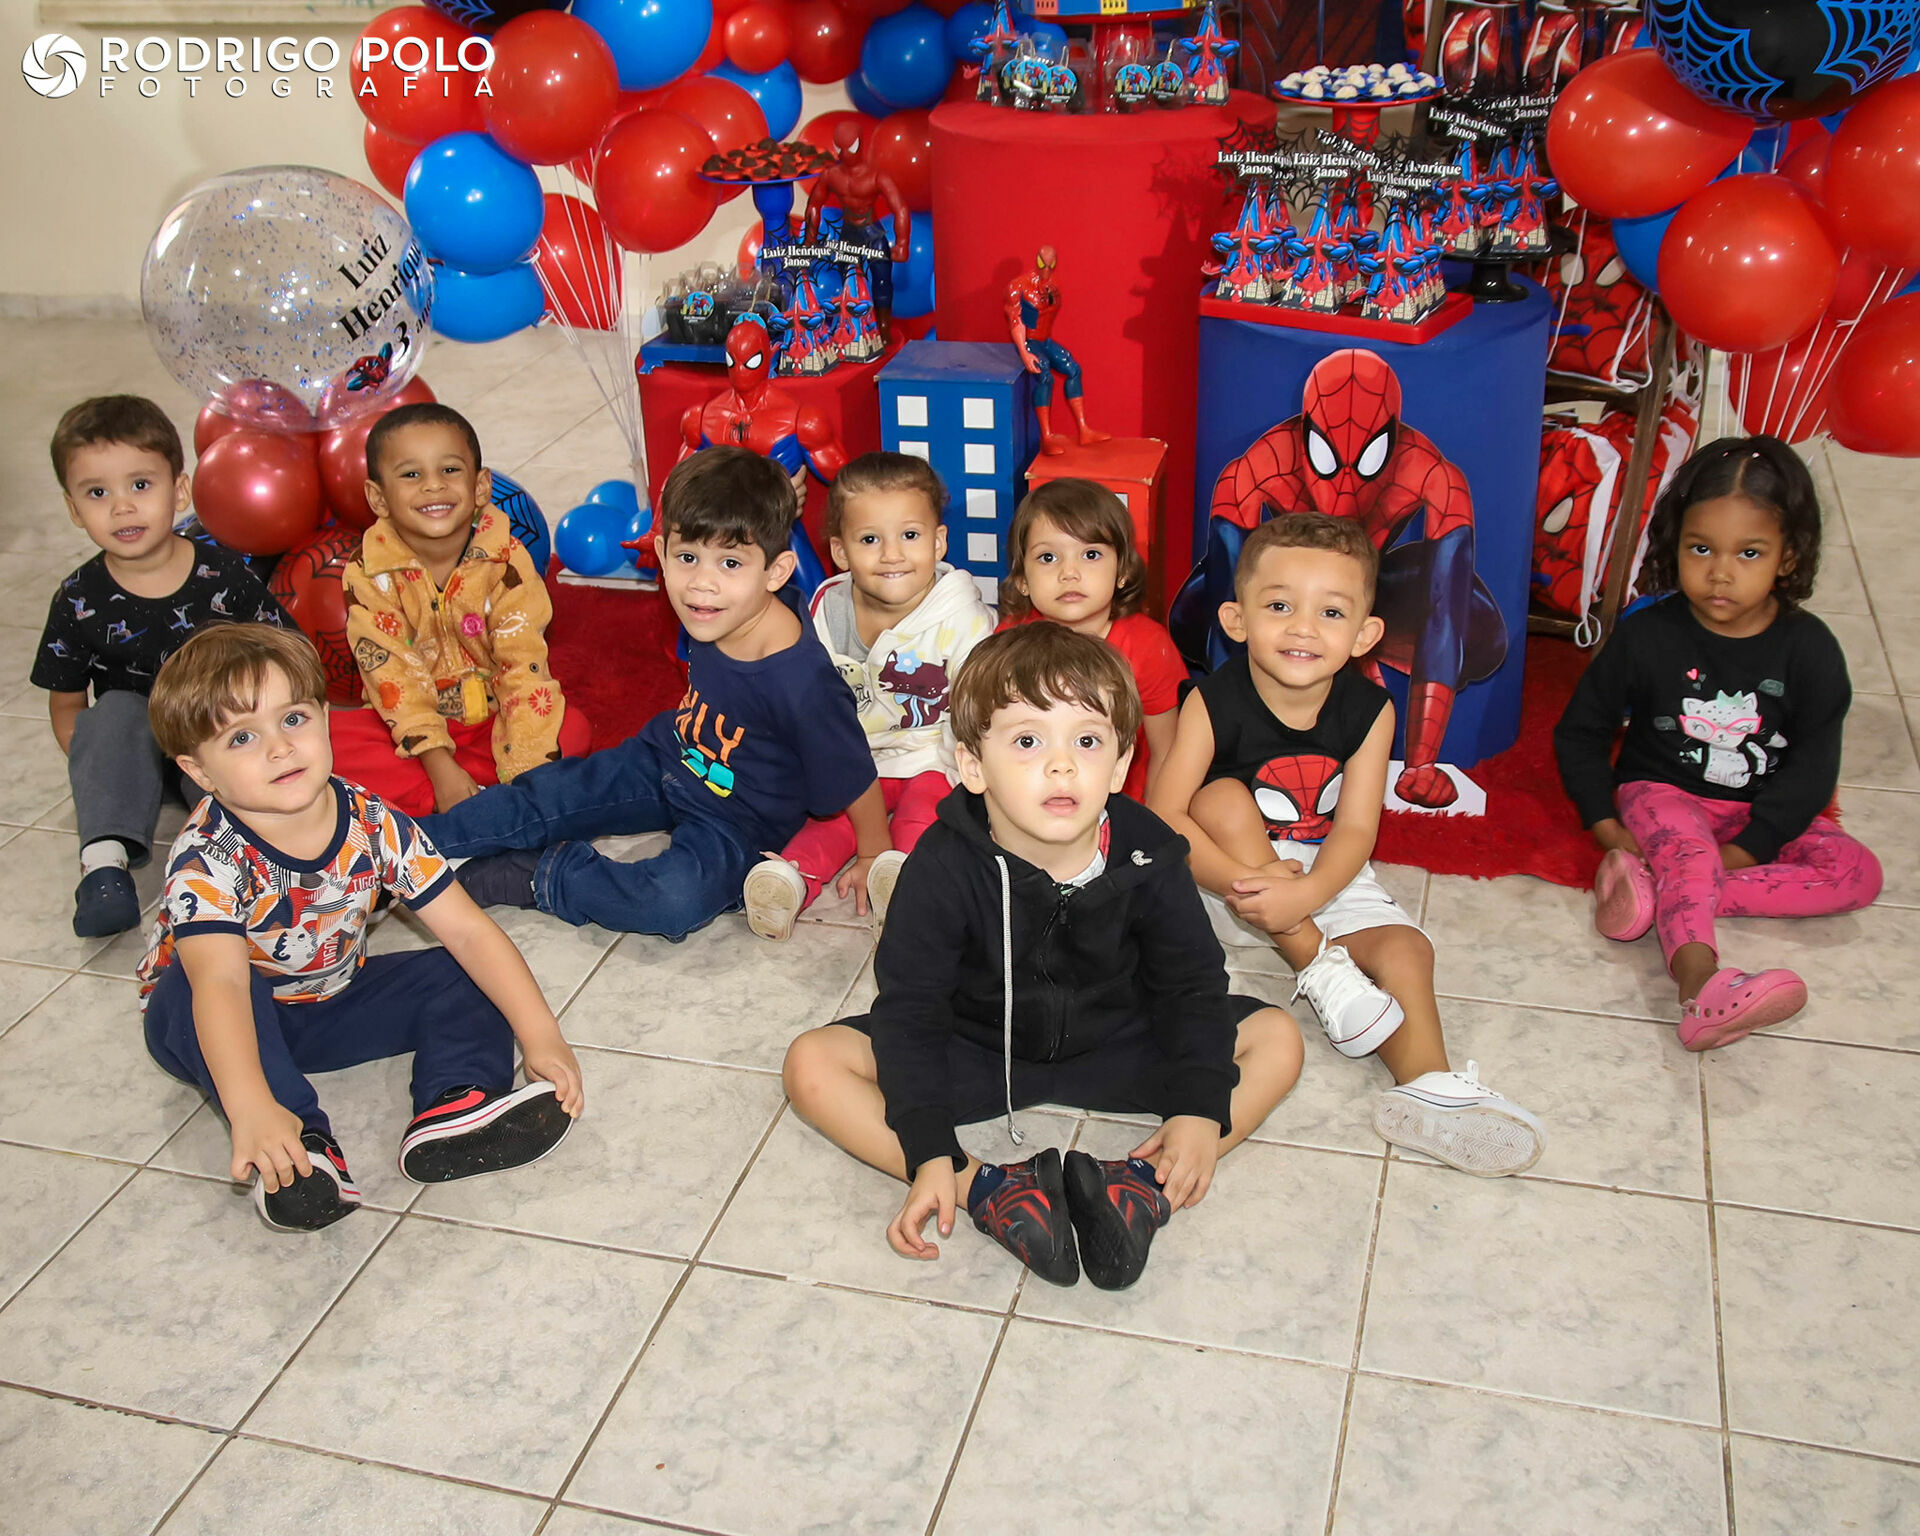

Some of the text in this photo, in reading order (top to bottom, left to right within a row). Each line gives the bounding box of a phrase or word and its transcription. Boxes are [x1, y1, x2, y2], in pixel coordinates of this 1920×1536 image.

[1428, 106, 1454, 123] Luiz
[1455, 113, 1507, 137] Henrique
[1217, 150, 1244, 165] Luiz
[1293, 152, 1321, 167] Luiz
[1238, 163, 1273, 177] 3anos
[1312, 166, 1349, 180] 3anos
[1386, 173, 1432, 191] Henrique
[763, 245, 832, 260] Luiz Henrique
[839, 240, 885, 259] Henrique
[336, 233, 392, 291] Luiz
